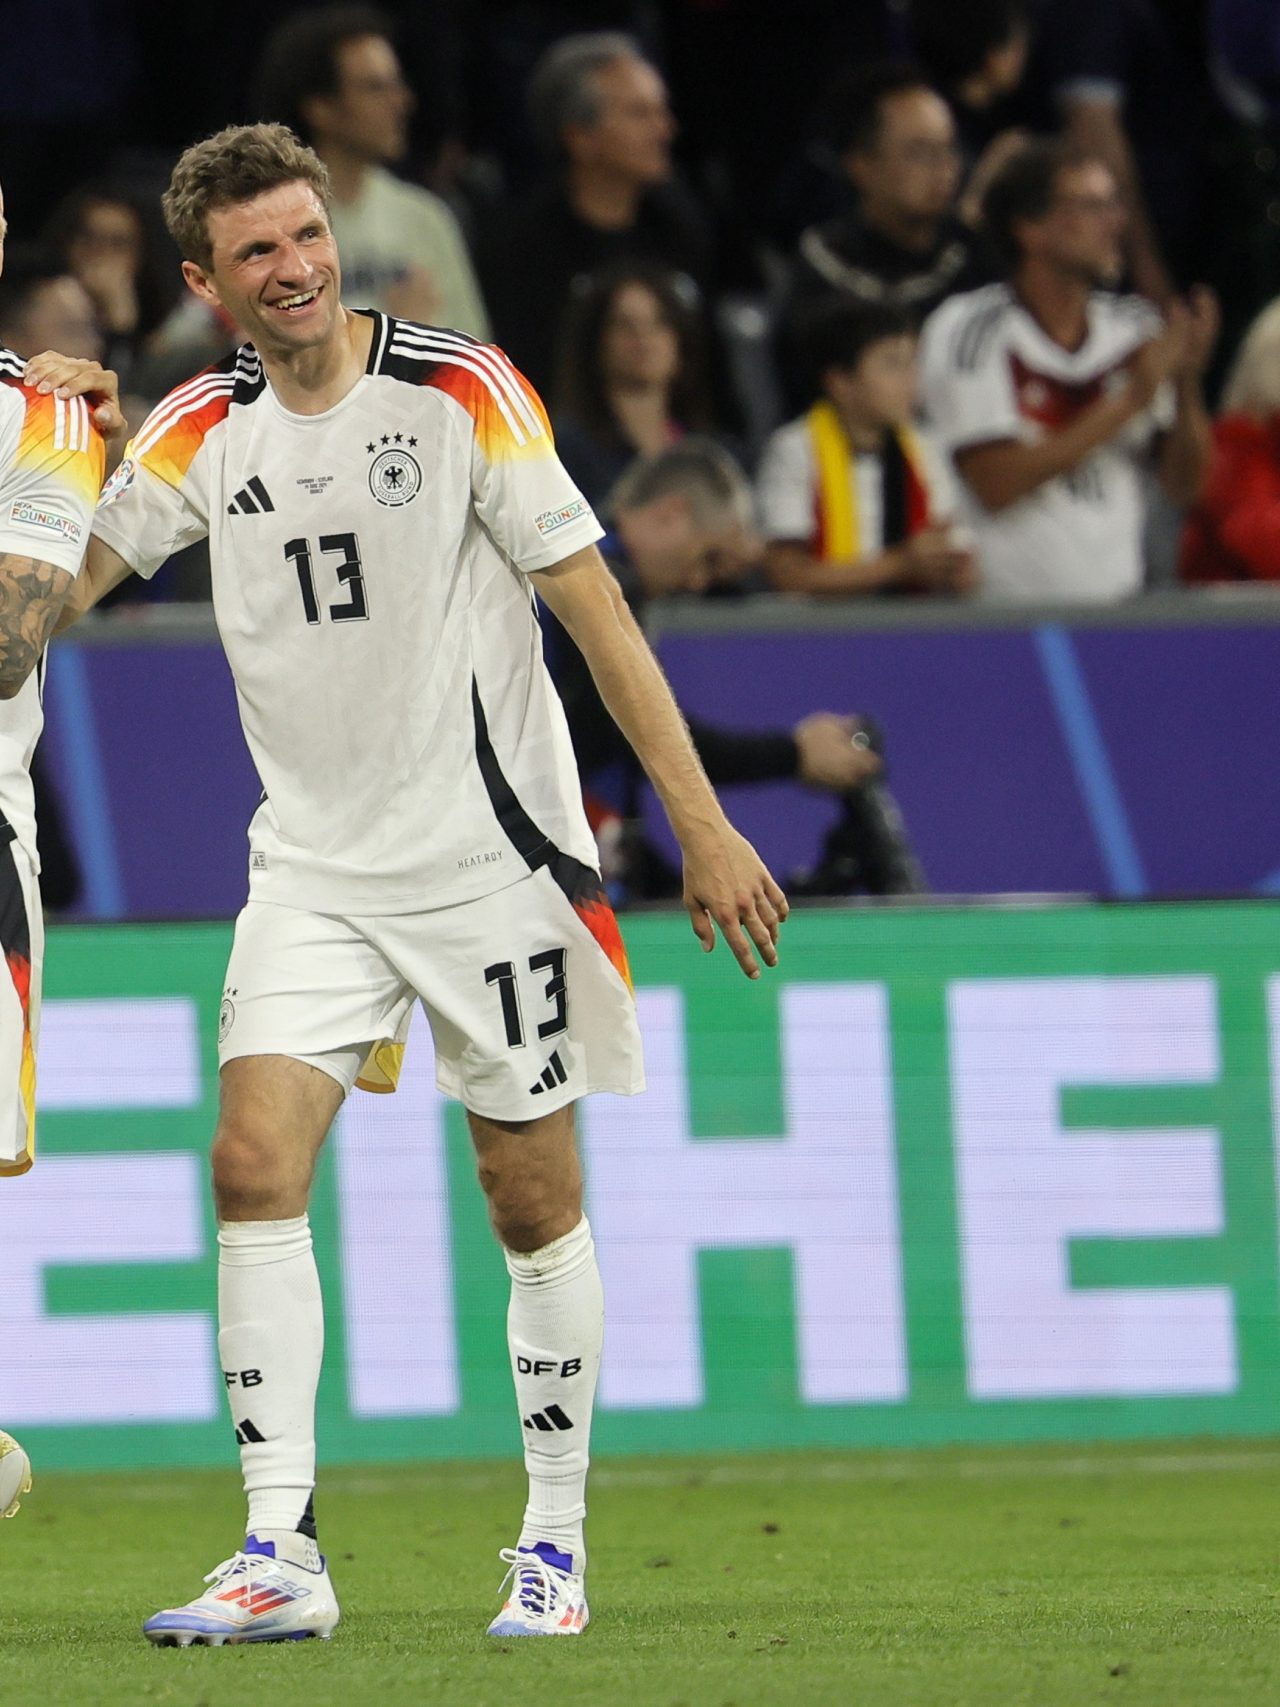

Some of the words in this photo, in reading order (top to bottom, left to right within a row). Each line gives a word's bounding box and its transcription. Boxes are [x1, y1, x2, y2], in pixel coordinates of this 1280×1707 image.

[11, 507, 81, 537] FOUNDATION
[284, 532, 370, 625] 13
[484, 947, 568, 1049] 13
[224, 1369, 263, 1389] FB
[517, 1355, 582, 1378] DFB
